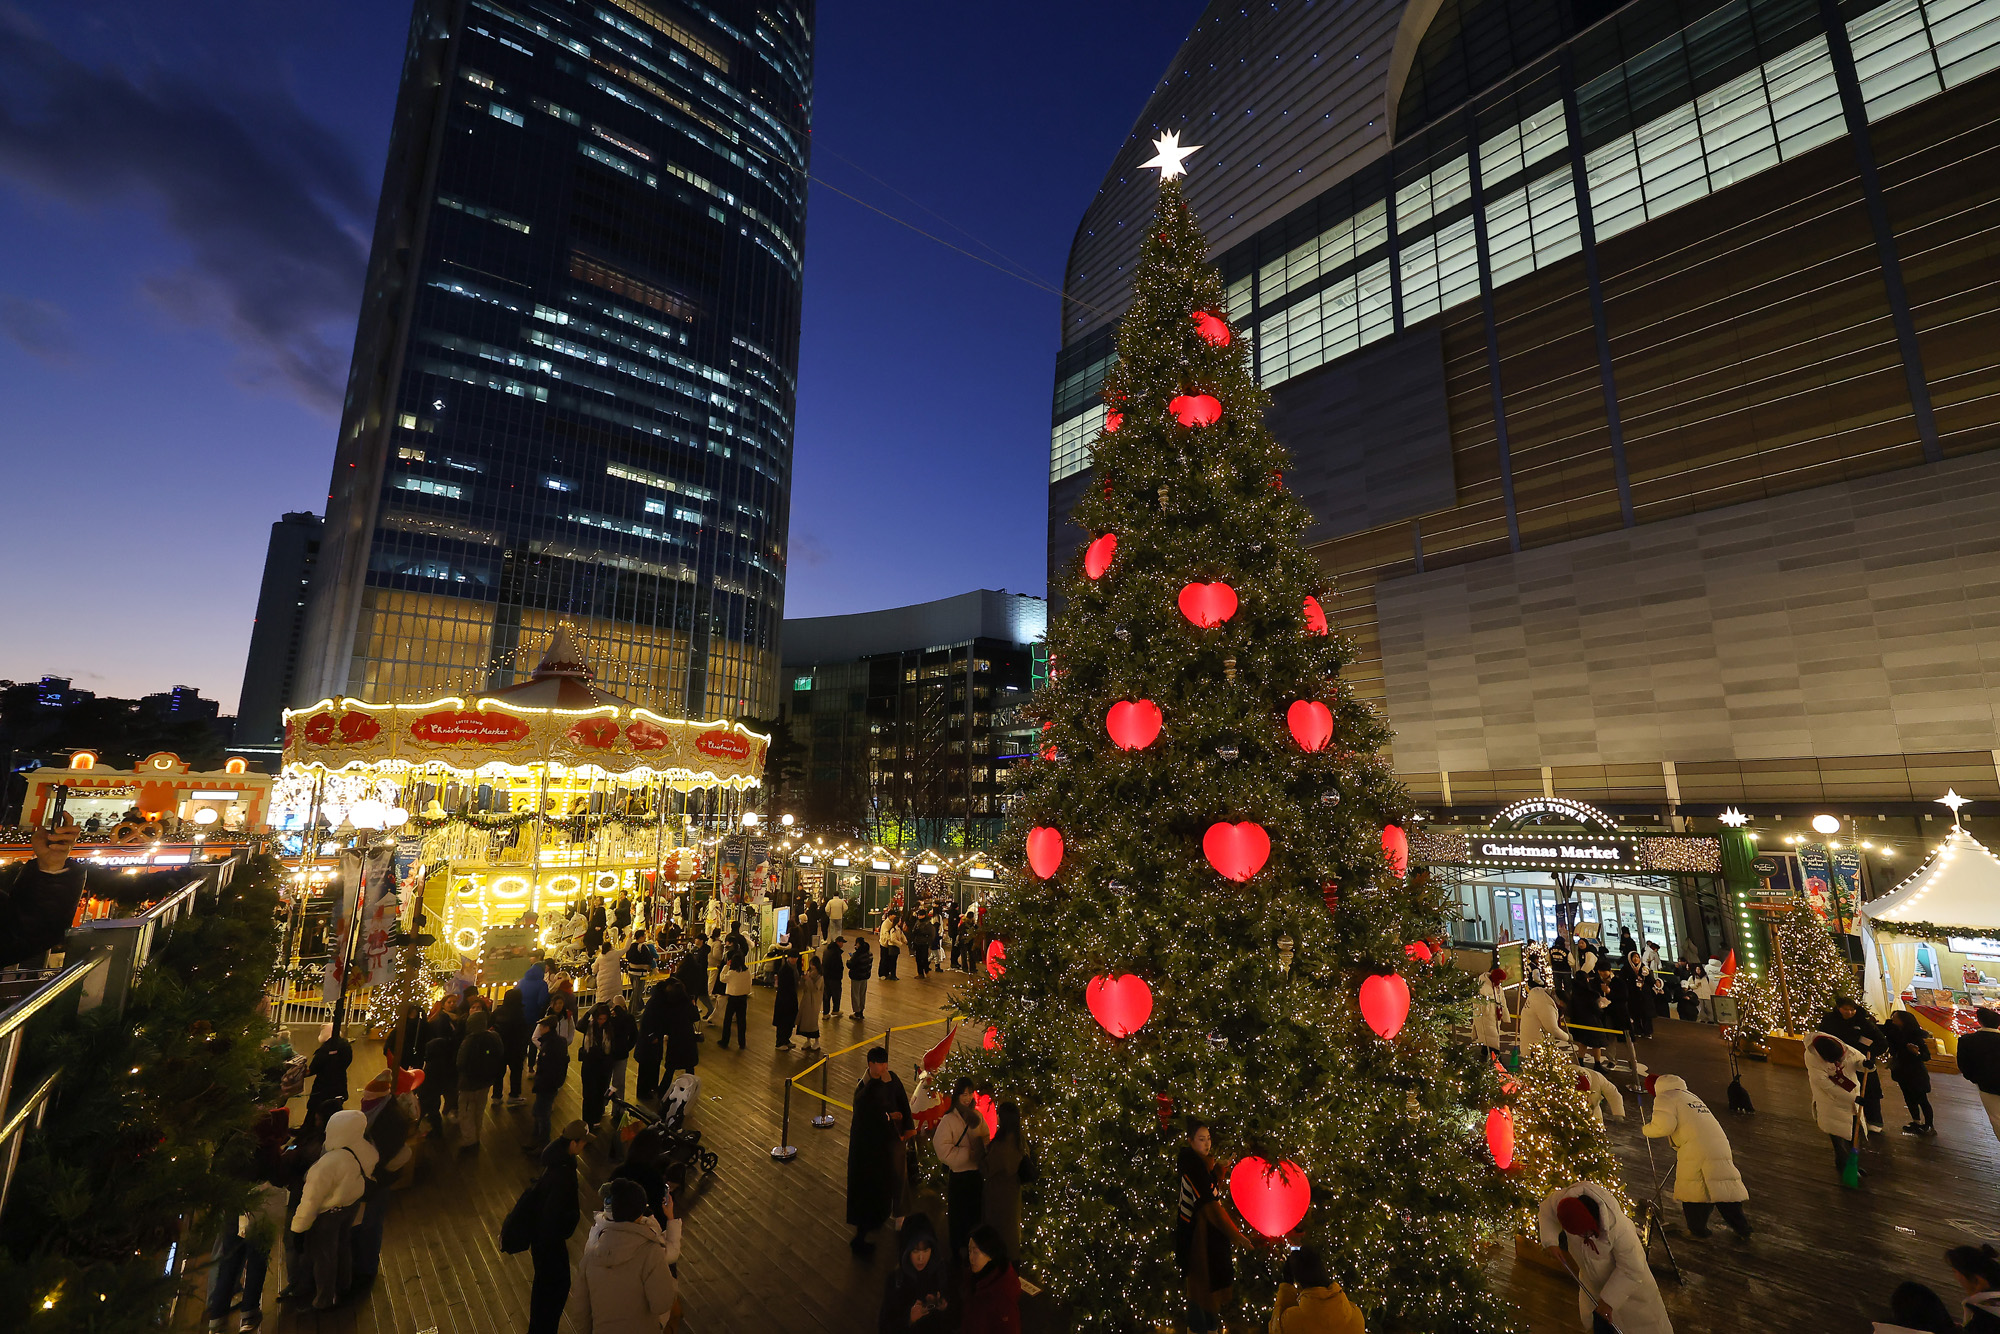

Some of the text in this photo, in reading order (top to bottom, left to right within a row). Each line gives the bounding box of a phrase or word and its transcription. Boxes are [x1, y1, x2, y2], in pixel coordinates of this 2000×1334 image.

[431, 723, 509, 735] Christmas Market
[1506, 802, 1589, 824] LOTTE TOWN
[1482, 843, 1620, 860] Christmas Market
